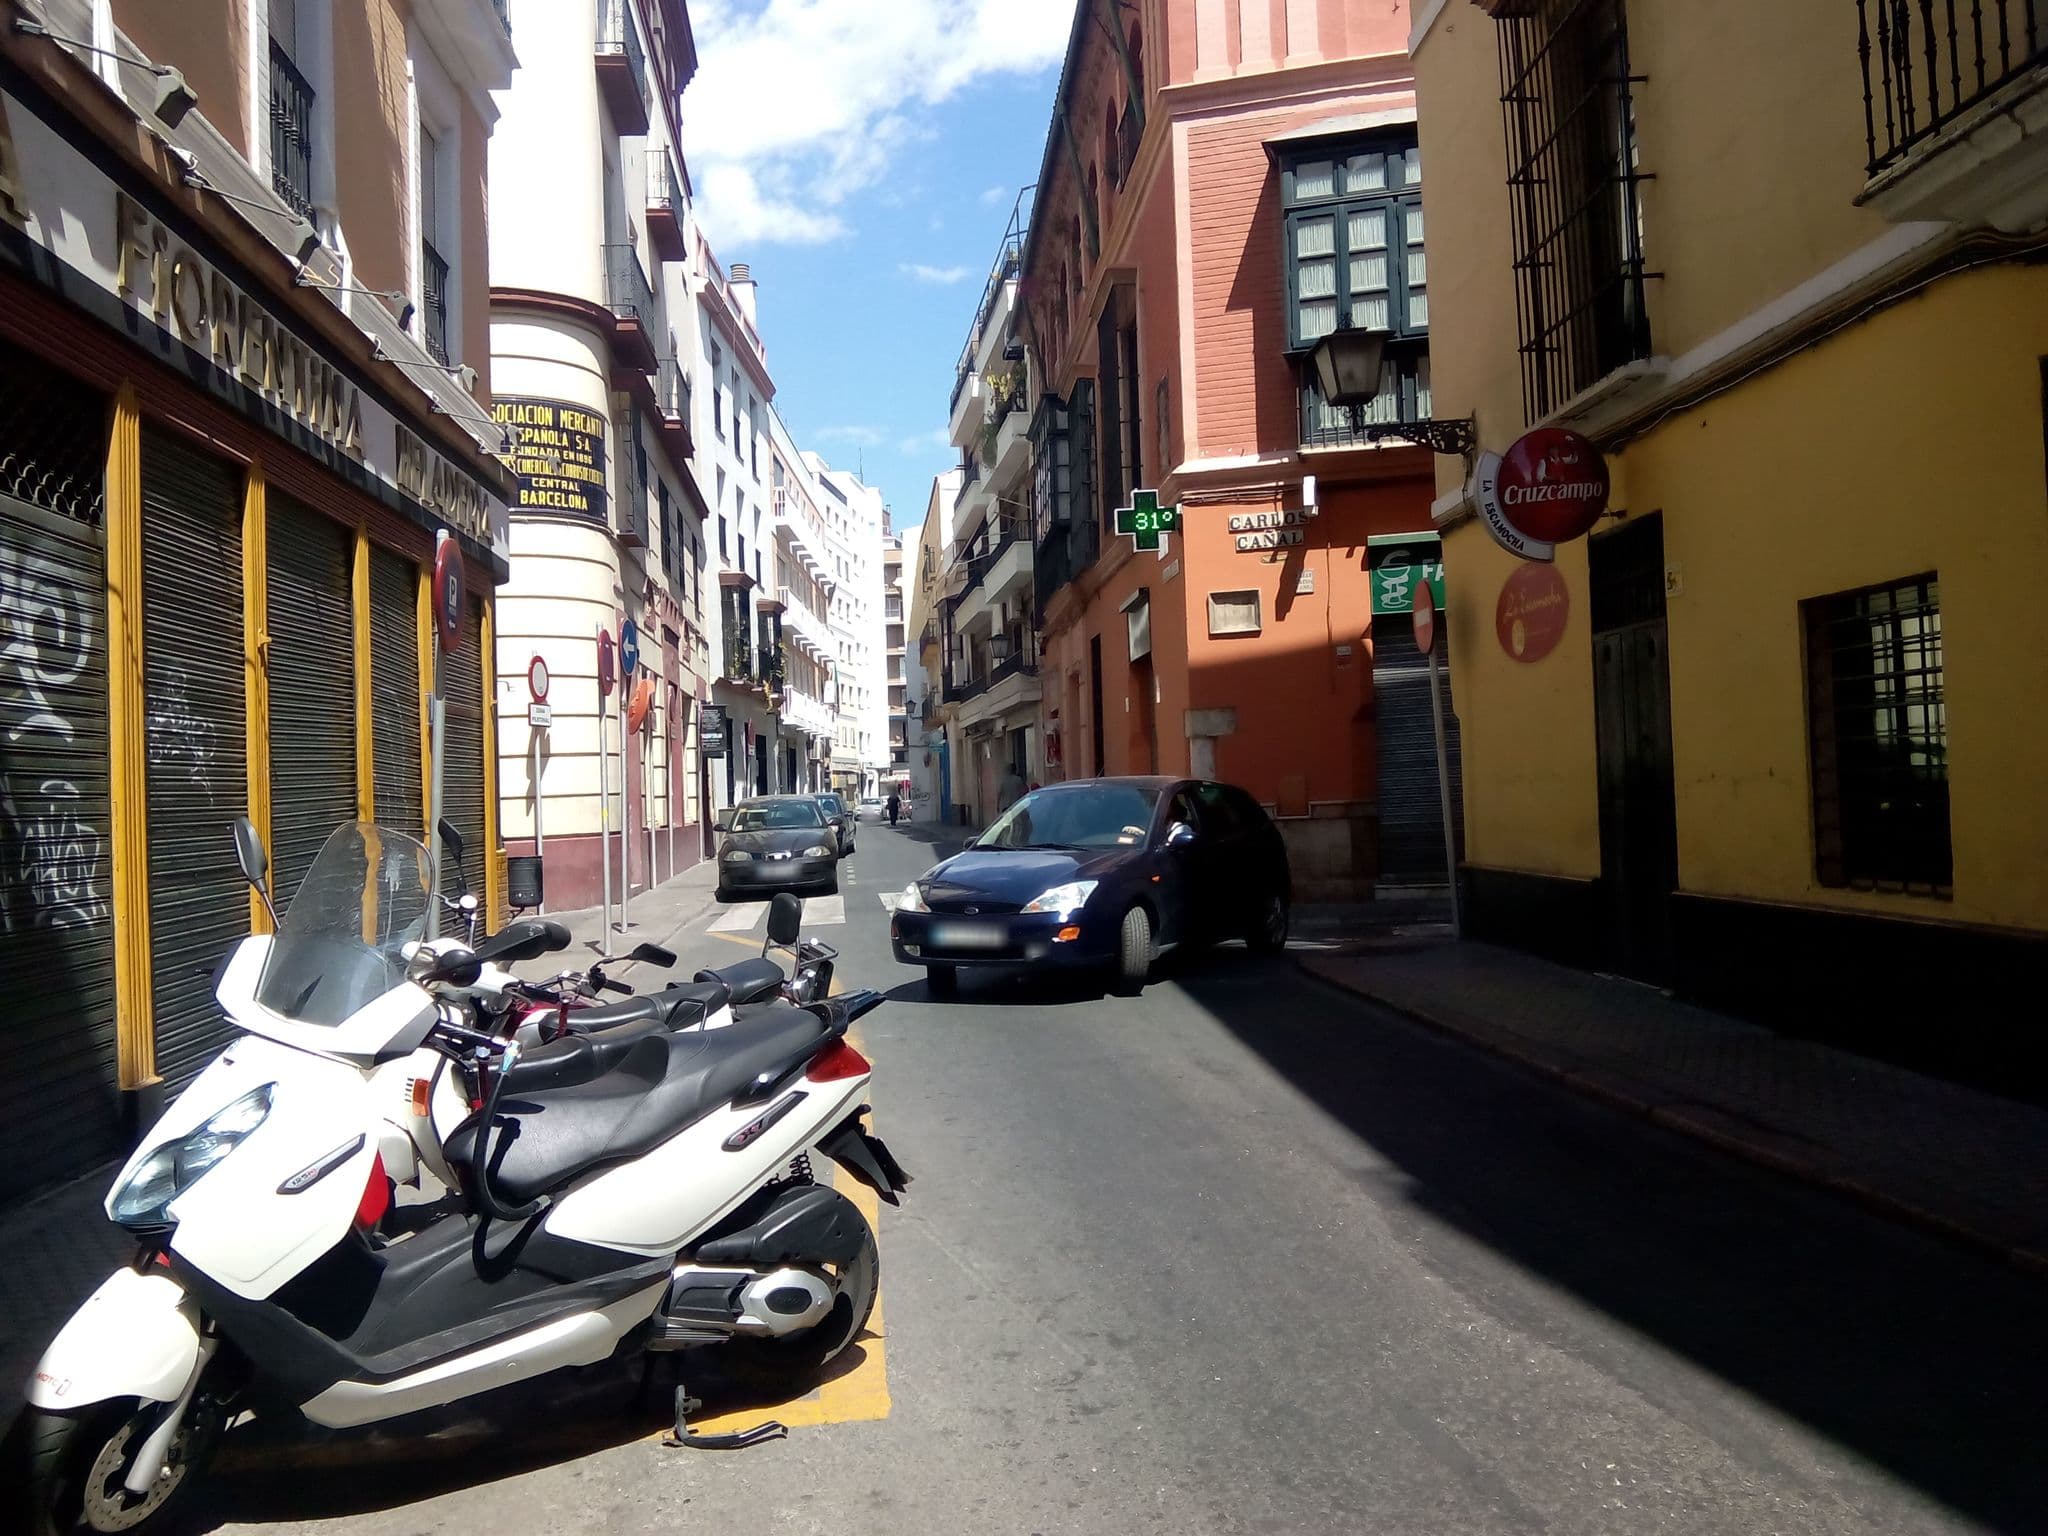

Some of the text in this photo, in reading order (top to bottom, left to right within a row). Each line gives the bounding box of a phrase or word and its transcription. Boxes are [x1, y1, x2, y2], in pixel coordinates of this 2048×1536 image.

[563, 451, 575, 460] EN
[531, 478, 580, 491] CENTRAL
[1504, 482, 1602, 505] Cruzcampo
[520, 490, 588, 510] BARCELONA
[1229, 512, 1308, 530] CARLOS
[1483, 479, 1525, 551] LA ESCAMOCHA
[1237, 529, 1302, 549] CAÑAL
